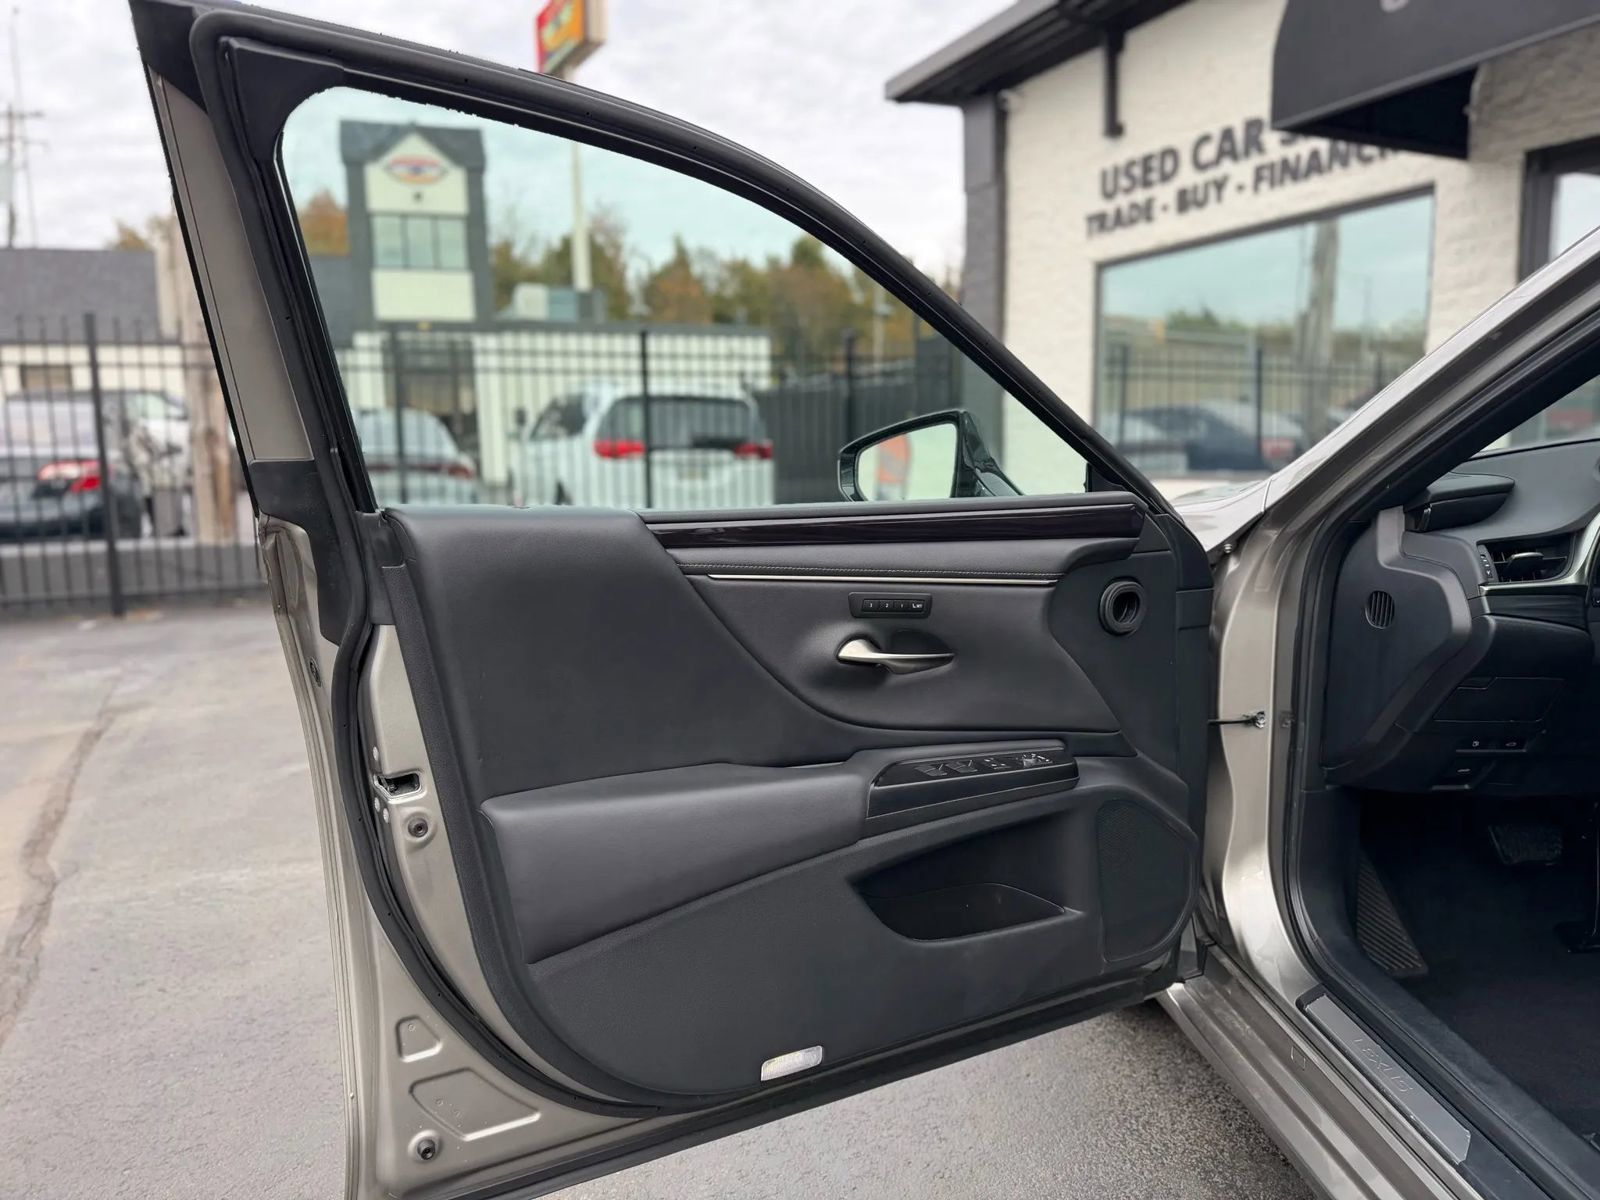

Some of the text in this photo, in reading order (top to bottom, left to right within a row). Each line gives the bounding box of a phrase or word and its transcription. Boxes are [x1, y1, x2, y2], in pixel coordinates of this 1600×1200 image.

[1085, 141, 1398, 236] TRADE BUY FINANC
[1100, 118, 1266, 200] USED CAR
